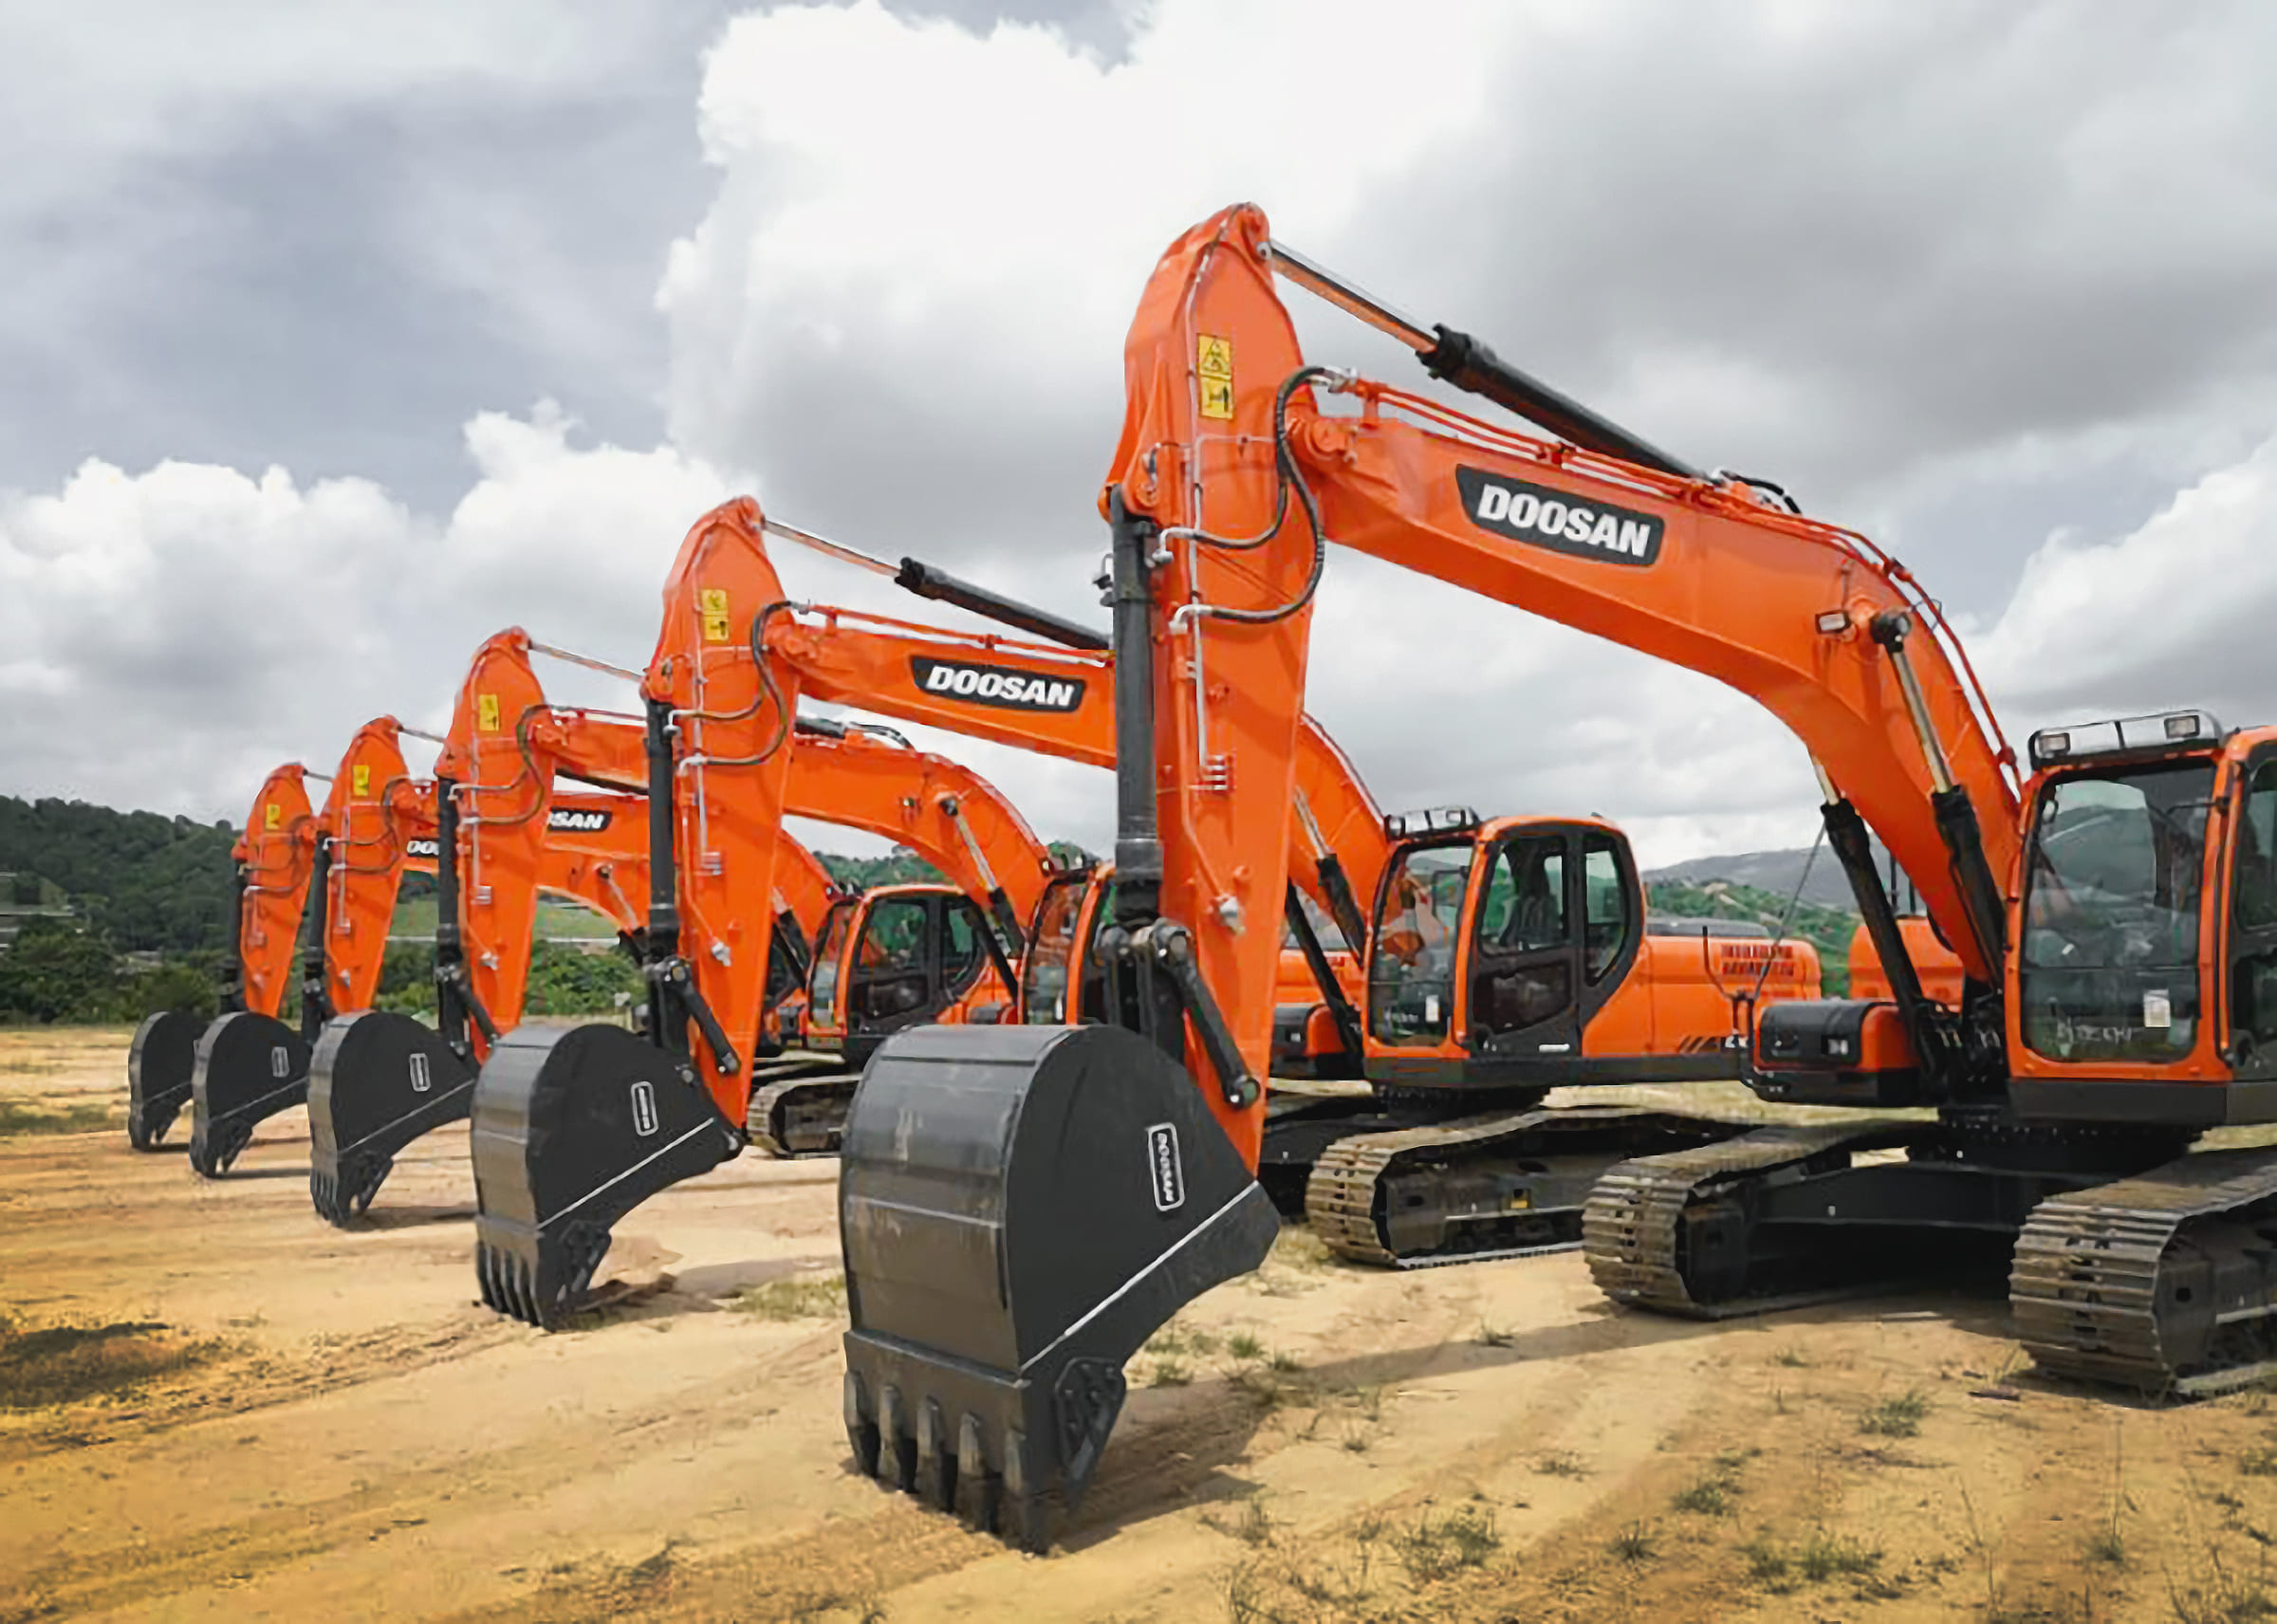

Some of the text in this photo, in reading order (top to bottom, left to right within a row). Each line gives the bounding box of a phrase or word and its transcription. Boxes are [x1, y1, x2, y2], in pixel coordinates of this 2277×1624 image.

[1477, 484, 1651, 557] DOOSAN
[926, 666, 1075, 707] DOOSAN
[547, 811, 604, 829] SAN
